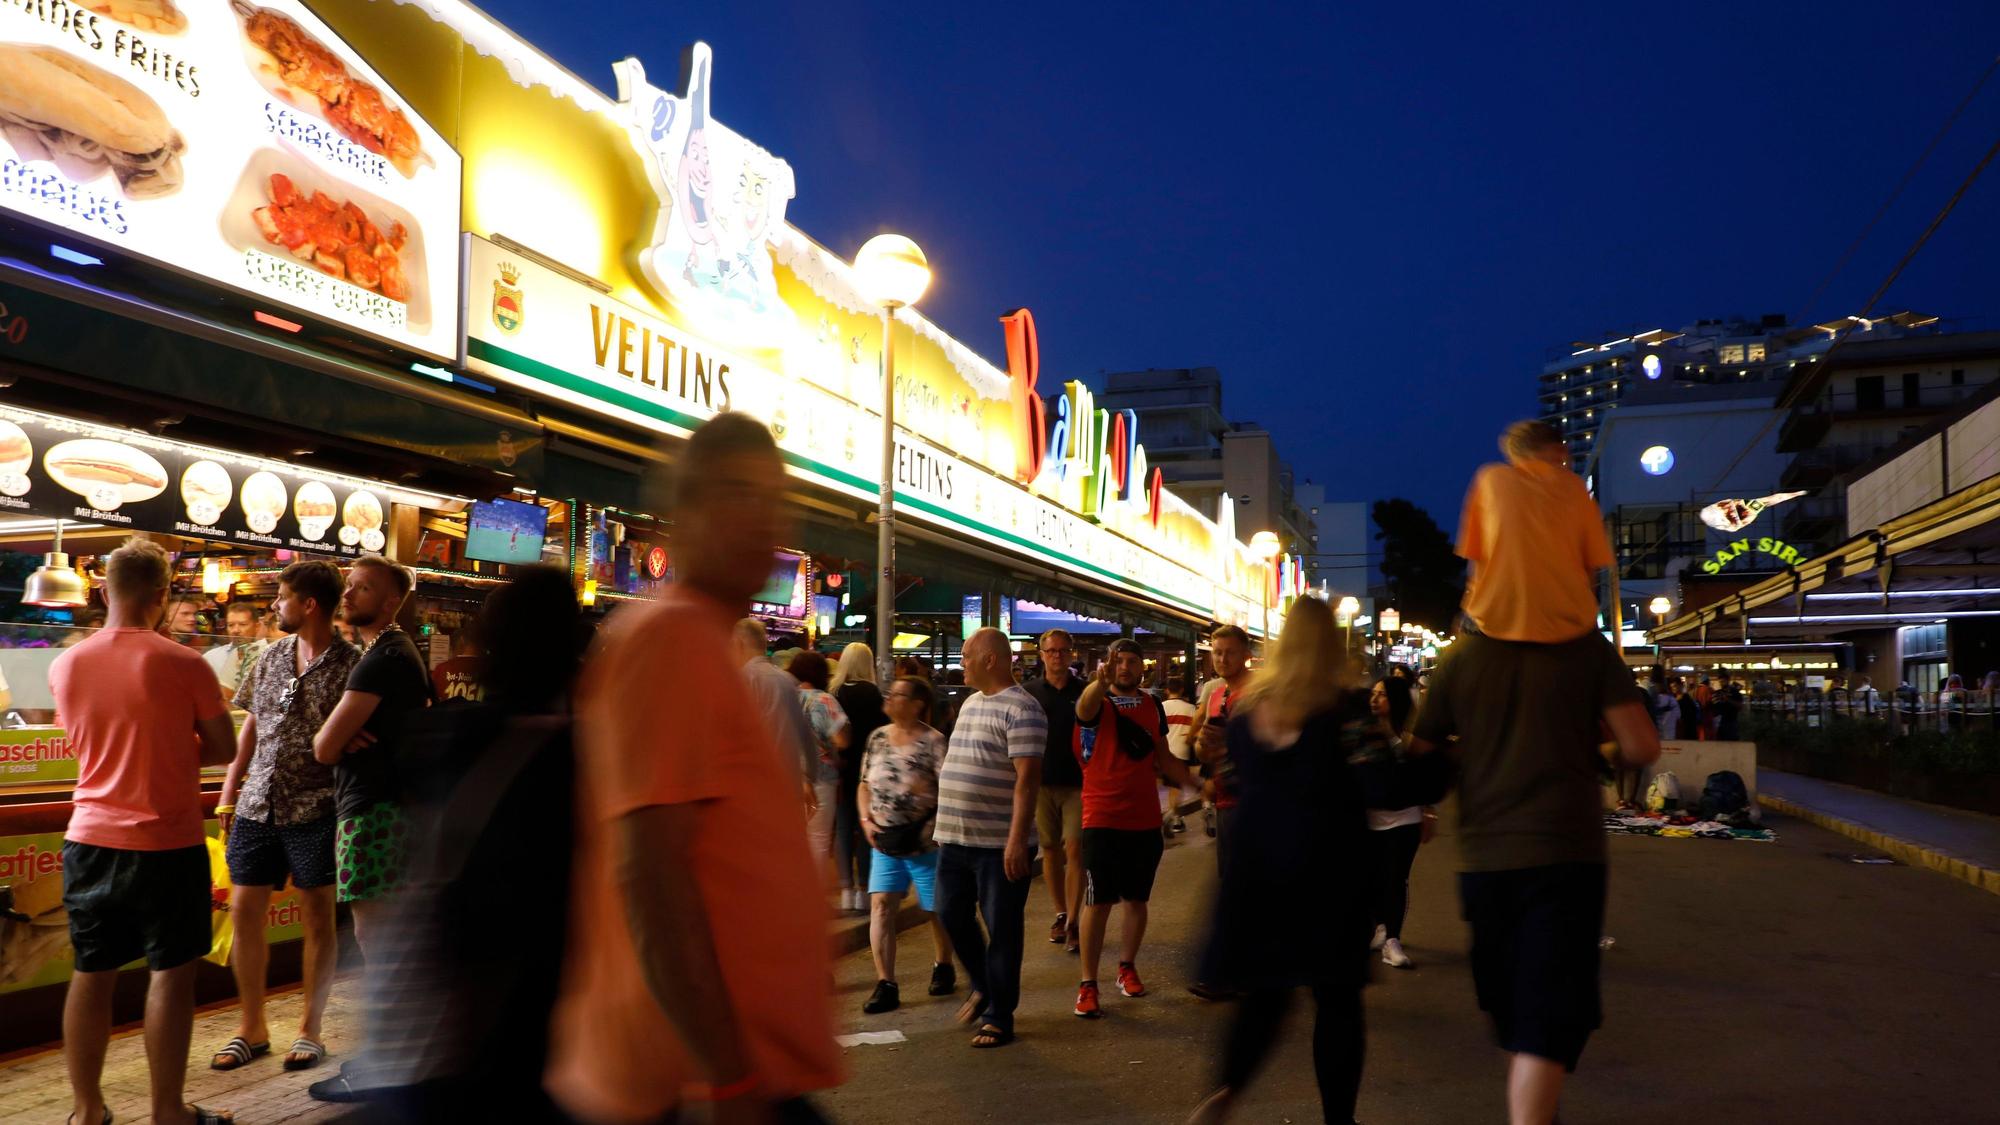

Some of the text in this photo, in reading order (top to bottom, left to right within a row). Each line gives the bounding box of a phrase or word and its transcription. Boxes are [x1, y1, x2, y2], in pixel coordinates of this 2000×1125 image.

[114, 29, 201, 98] FRITES
[264, 102, 388, 185] SCHASCHLIK
[588, 302, 732, 415] VELTINS
[74, 506, 132, 523] Mit Brötchen
[175, 521, 227, 537] Mit Brötchen
[249, 532, 282, 545] Brötchen
[1702, 538, 1750, 575] SAN
[0, 737, 73, 763] aschlik
